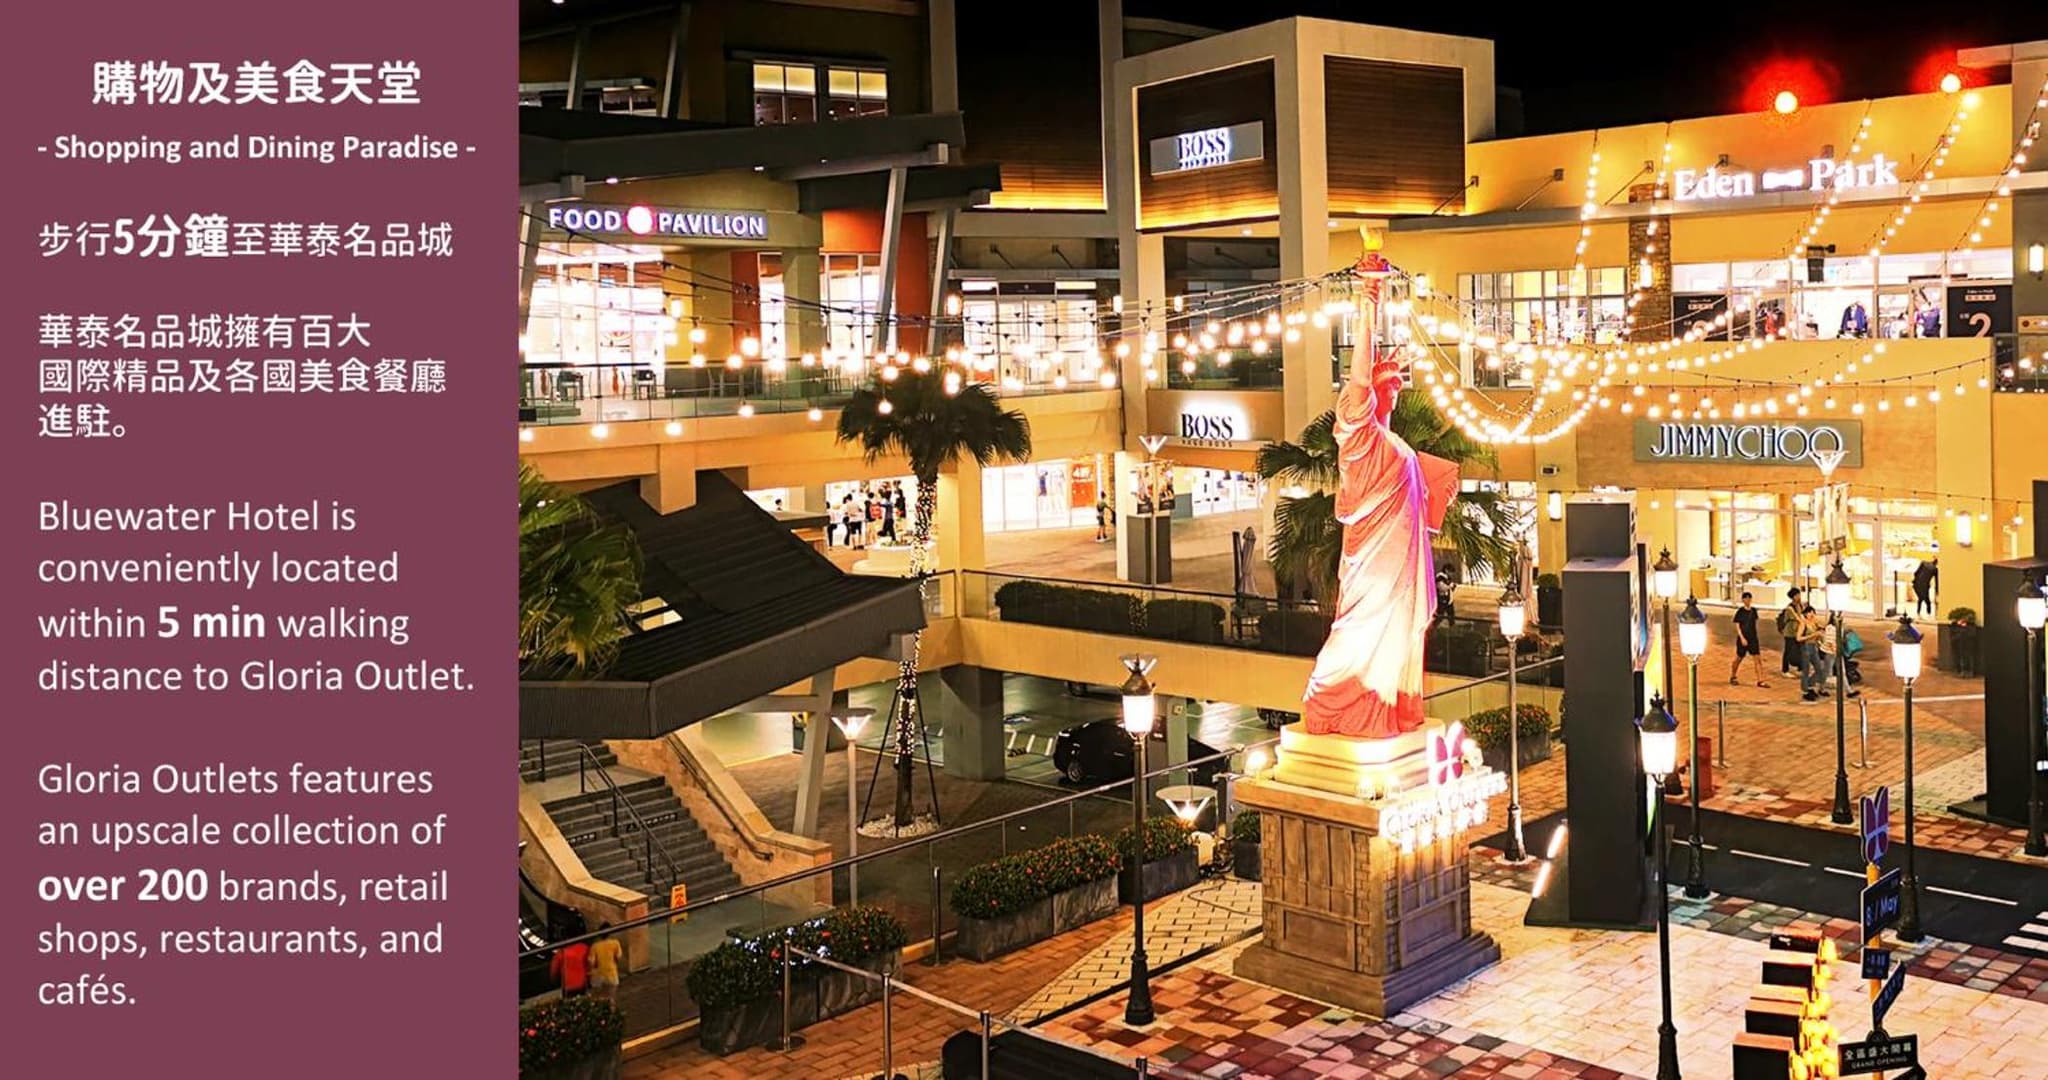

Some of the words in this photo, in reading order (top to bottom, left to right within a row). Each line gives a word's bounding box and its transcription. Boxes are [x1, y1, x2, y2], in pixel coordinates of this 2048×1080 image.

[1177, 131, 1227, 159] BOSS
[1674, 165, 1755, 200] Eden
[1809, 153, 1899, 191] Park
[549, 207, 622, 231] FOOD
[658, 212, 765, 236] PAVILION
[1181, 413, 1234, 440] BOSS
